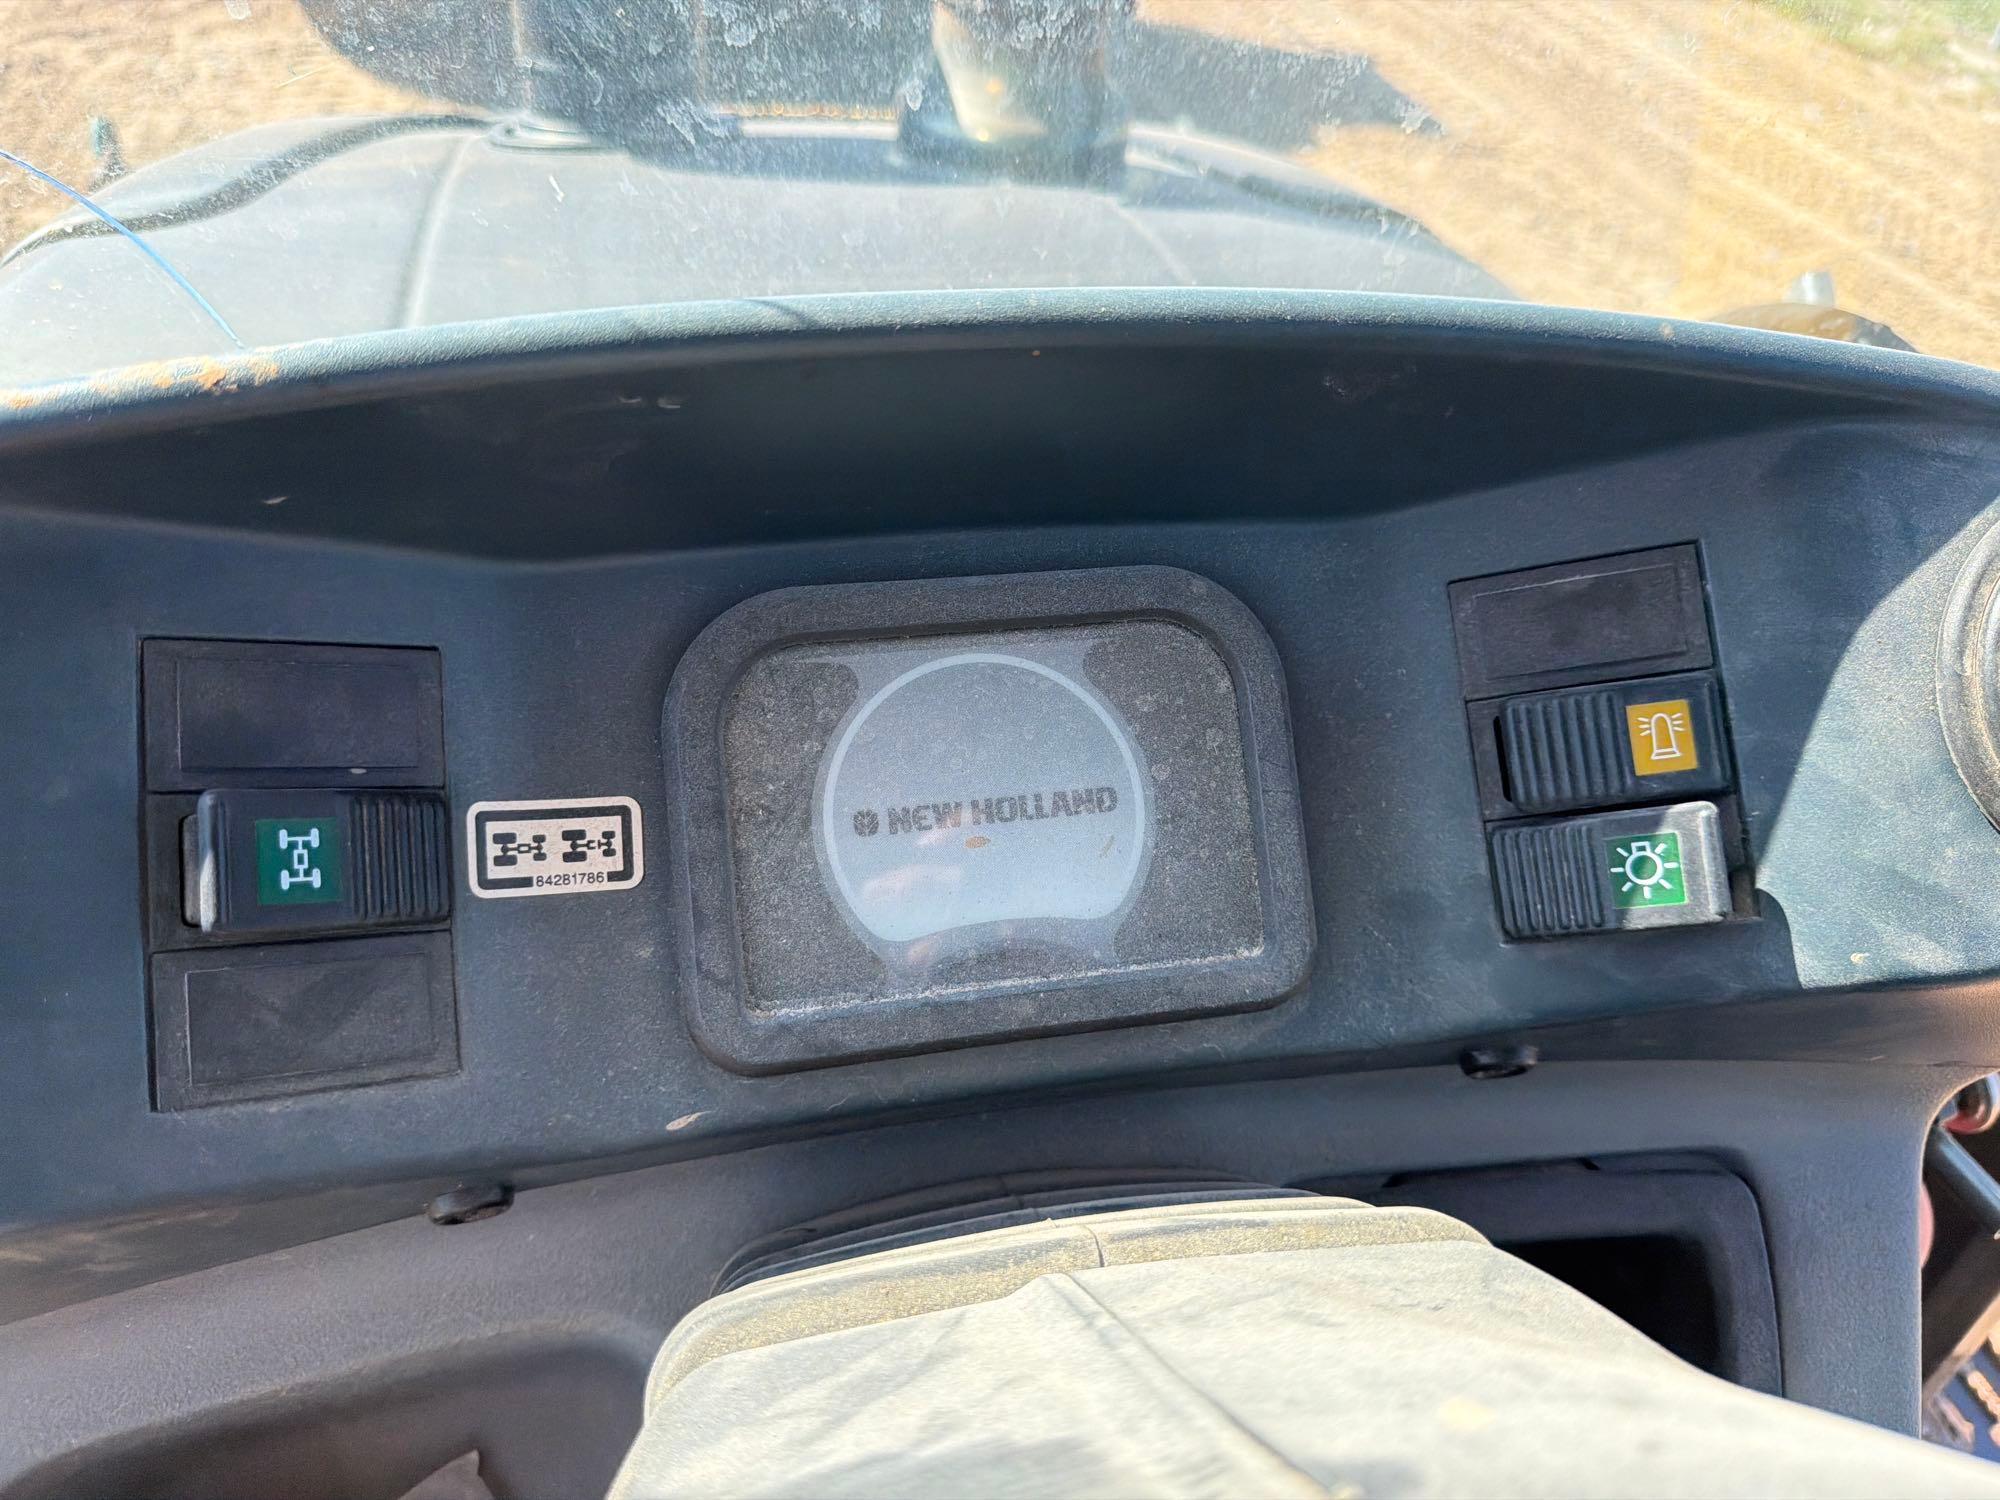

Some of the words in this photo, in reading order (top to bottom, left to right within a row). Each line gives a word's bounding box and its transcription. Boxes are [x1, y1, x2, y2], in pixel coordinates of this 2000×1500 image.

[887, 801, 962, 835] NEW
[970, 786, 1118, 825] HOLLAND
[535, 871, 605, 887] 84281786
